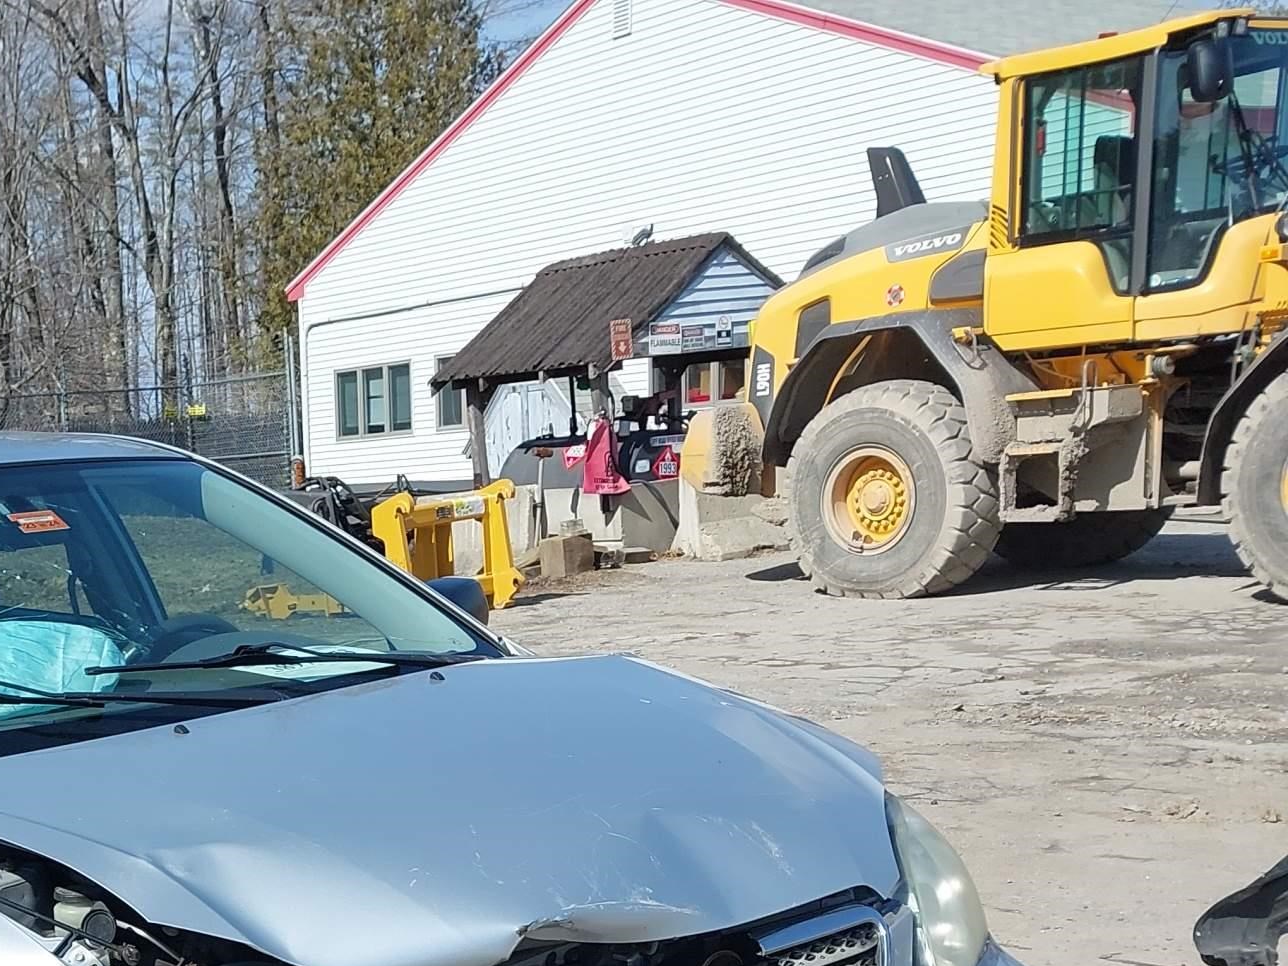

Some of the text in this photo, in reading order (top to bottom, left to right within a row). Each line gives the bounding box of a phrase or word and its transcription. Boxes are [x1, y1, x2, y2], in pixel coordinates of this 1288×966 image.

[893, 232, 962, 257] VOLVO
[756, 363, 771, 397] L90H
[660, 462, 676, 474] 1993
